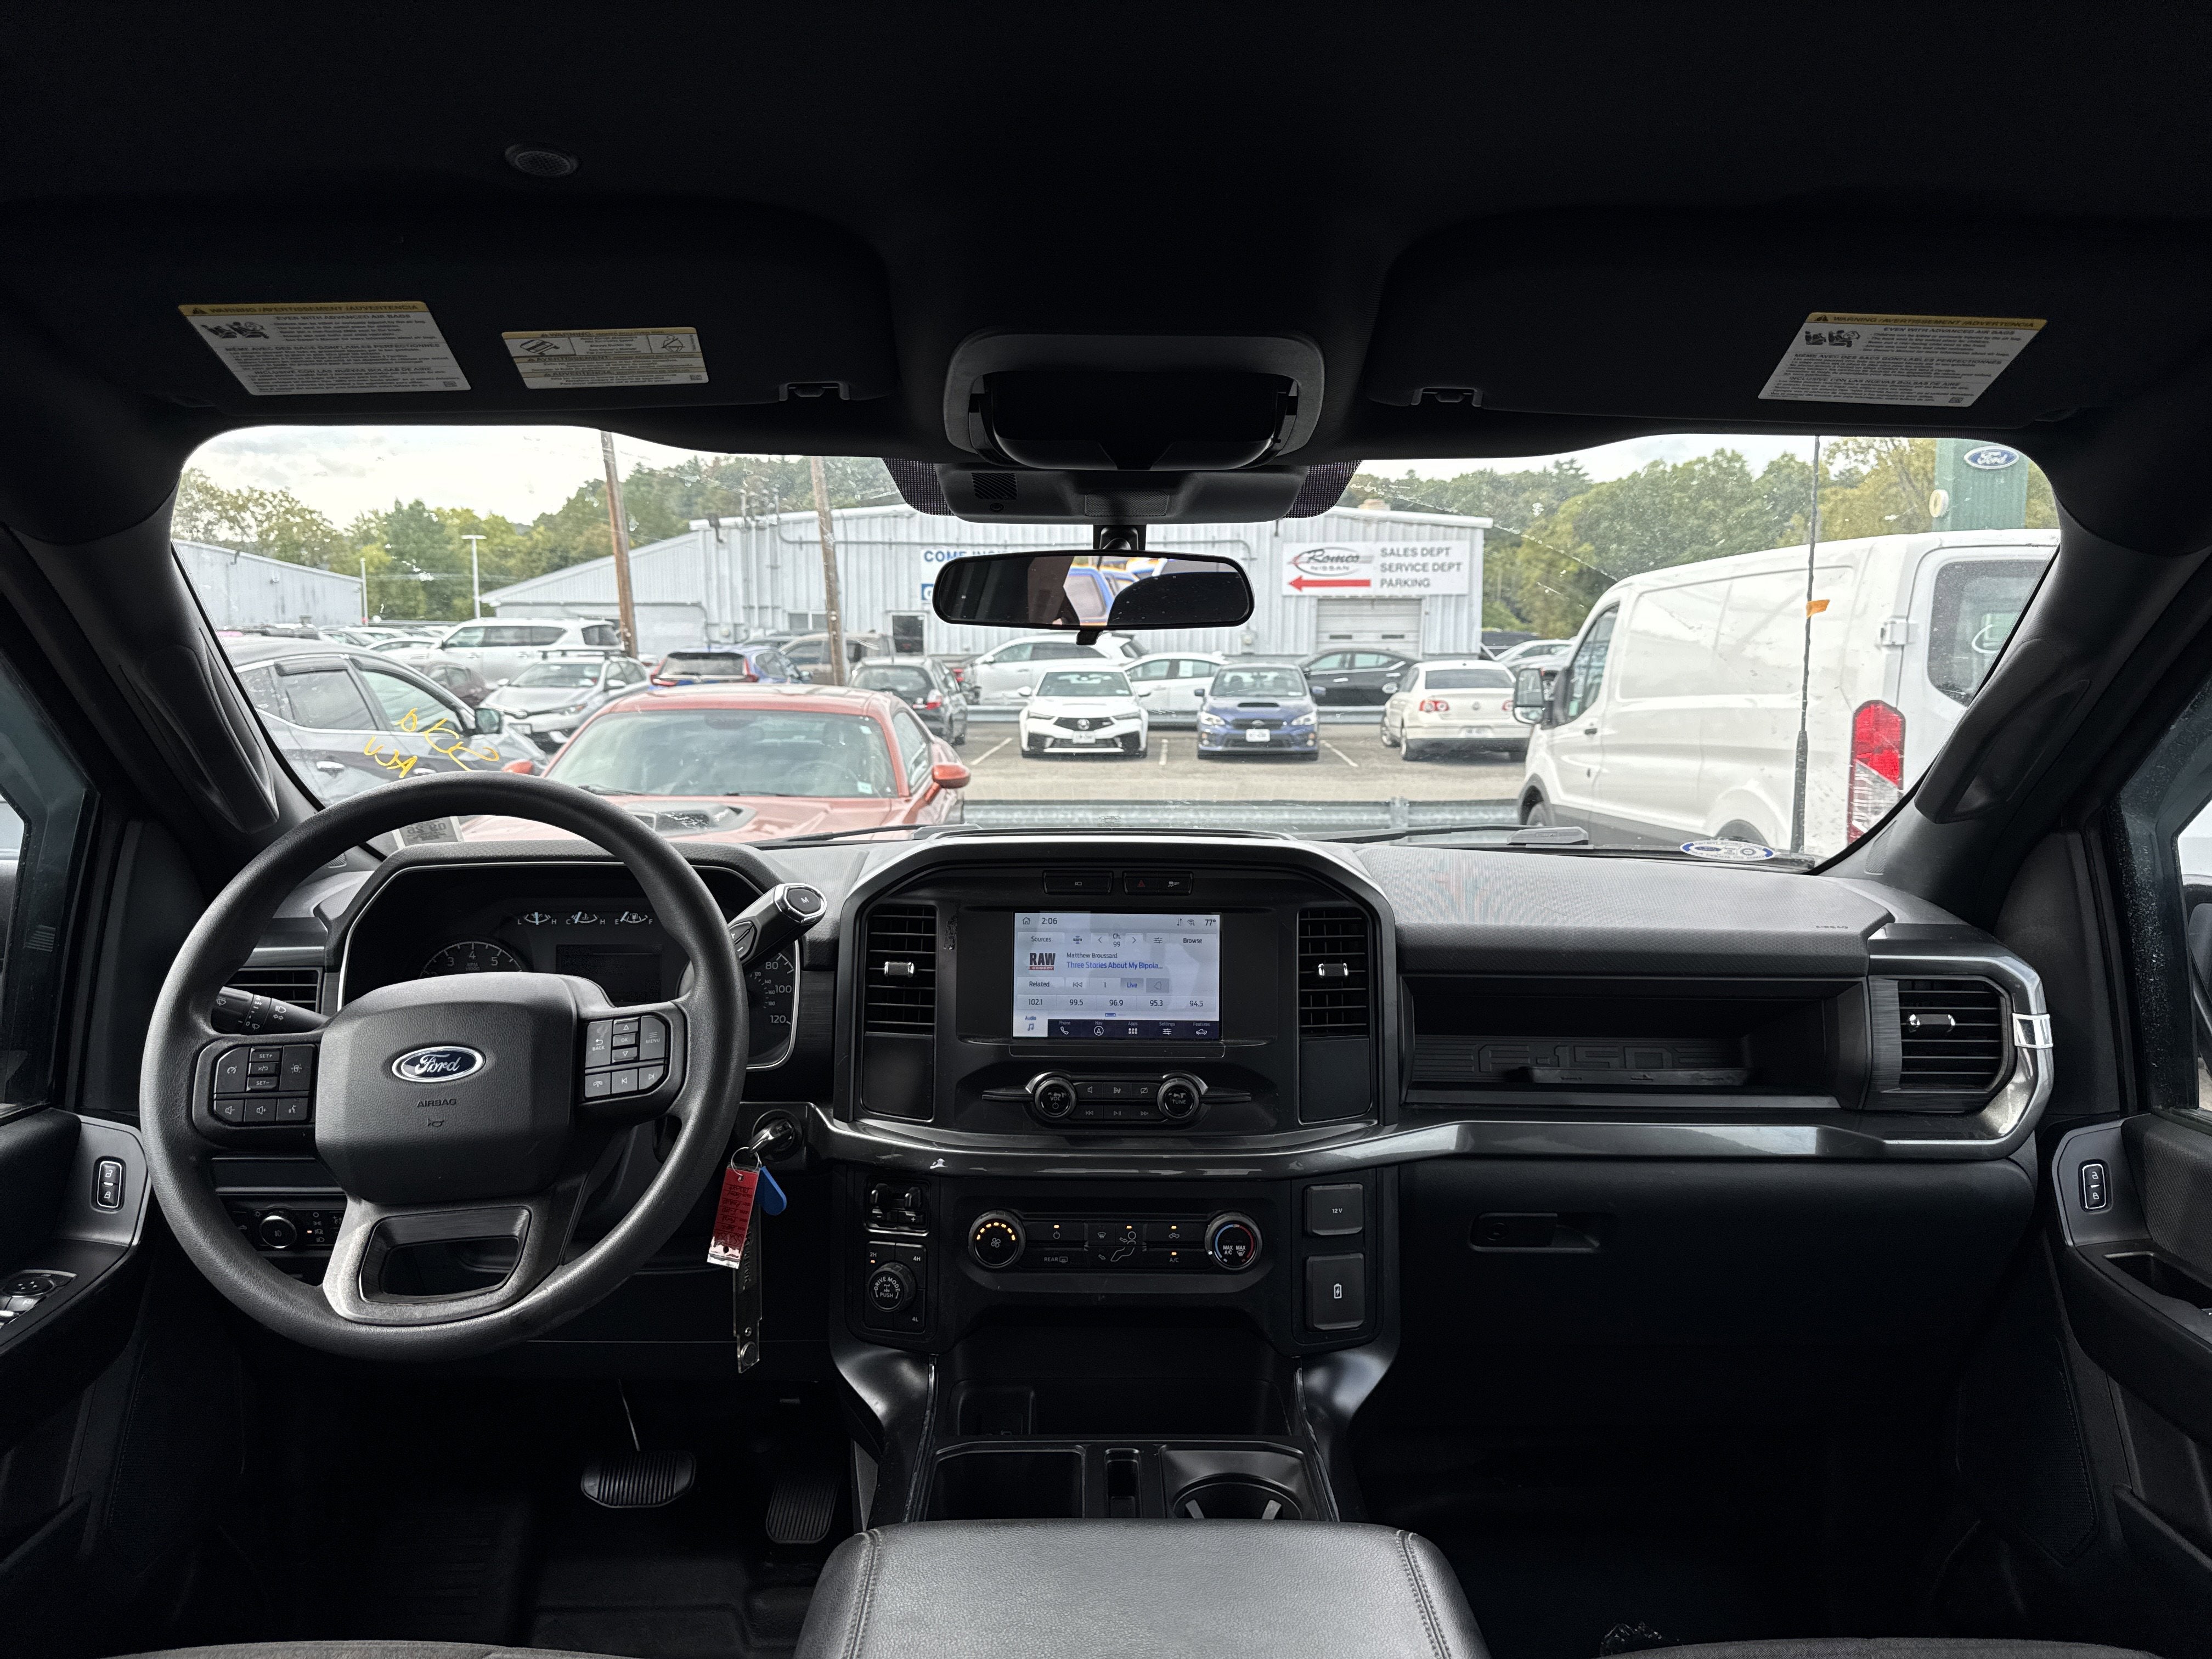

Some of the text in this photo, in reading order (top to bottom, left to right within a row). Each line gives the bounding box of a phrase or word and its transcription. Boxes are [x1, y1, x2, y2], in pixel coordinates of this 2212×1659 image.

[924, 551, 967, 562] COME
[1380, 547, 1451, 557] SALES DEPT
[1380, 562, 1462, 572] SERVICE DEPT
[1380, 578, 1431, 588] PARKING
[469, 950, 476, 960] 4
[1029, 952, 1056, 966] RAW
[447, 956, 455, 967] 3
[491, 957, 498, 966] 5
[765, 961, 778, 969] 80
[1128, 962, 1137, 970] My
[775, 985, 792, 993] 100
[770, 1014, 786, 1023] 120
[414, 1052, 461, 1075] Ford
[416, 1098, 456, 1107] AIRBAG
[873, 1276, 900, 1292] DRIVE MODE
